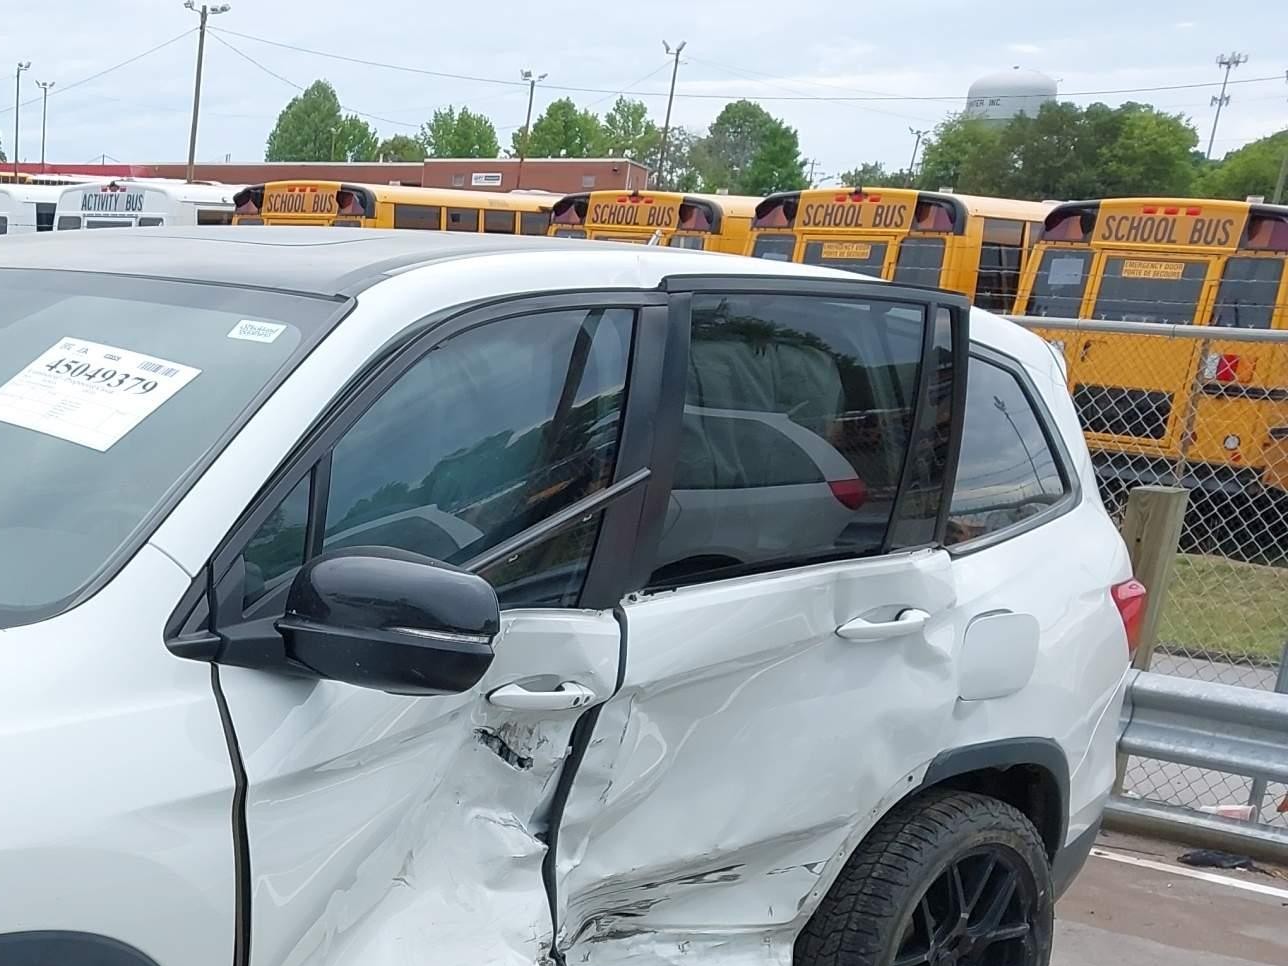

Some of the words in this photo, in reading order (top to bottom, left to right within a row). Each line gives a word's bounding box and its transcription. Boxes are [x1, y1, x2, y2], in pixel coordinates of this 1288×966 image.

[81, 193, 120, 211] ACTIVITY
[125, 194, 144, 211] BUS
[267, 193, 306, 212] SCHOOL
[312, 194, 334, 213] BUS
[592, 204, 640, 226] SCHOOL
[647, 206, 674, 227] BUS
[803, 204, 863, 227] SCHOOL
[872, 205, 907, 228] BUS
[1102, 215, 1177, 244] SCHOOL
[1189, 218, 1234, 246] BUS
[45, 357, 158, 395] 45049379
